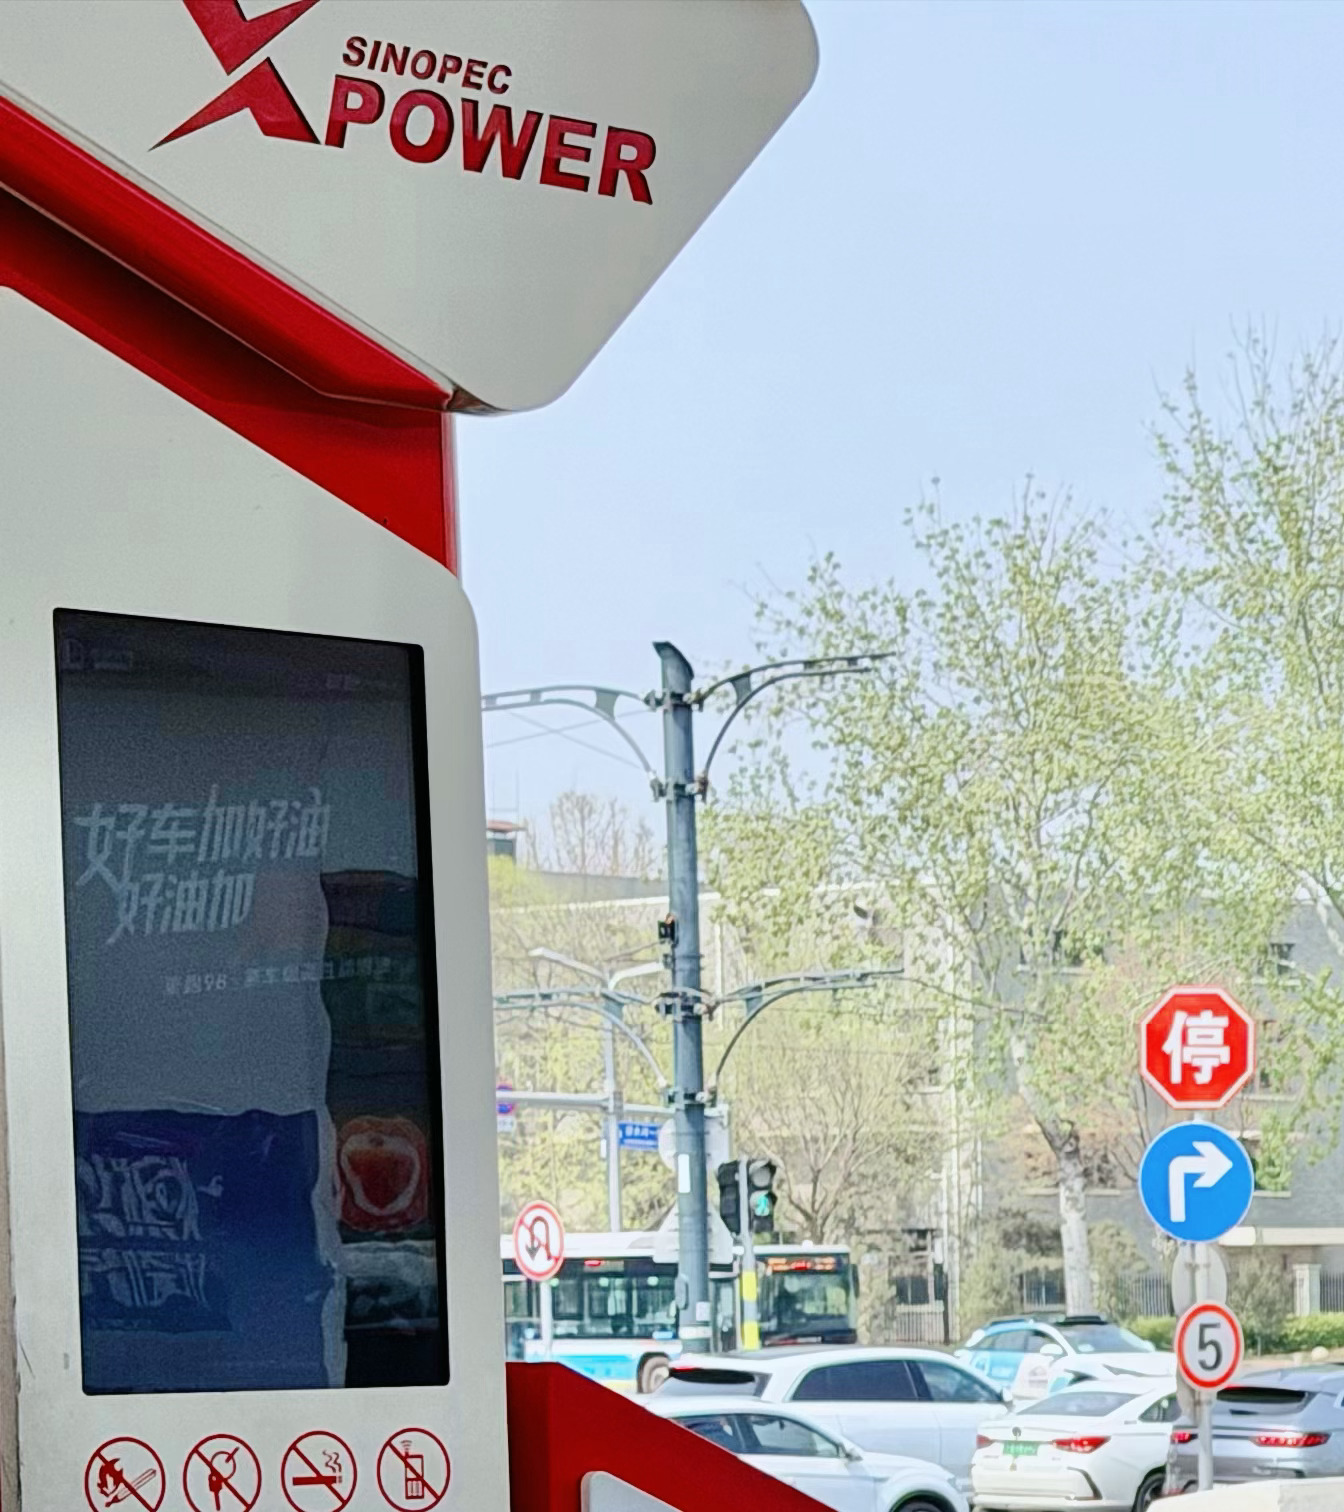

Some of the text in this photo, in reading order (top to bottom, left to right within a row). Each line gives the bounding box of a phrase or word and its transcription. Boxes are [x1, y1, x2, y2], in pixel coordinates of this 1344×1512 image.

[342, 36, 513, 95] SINOPEC
[1162, 1009, 1229, 1084] 停
[1198, 1323, 1222, 1371] 5
